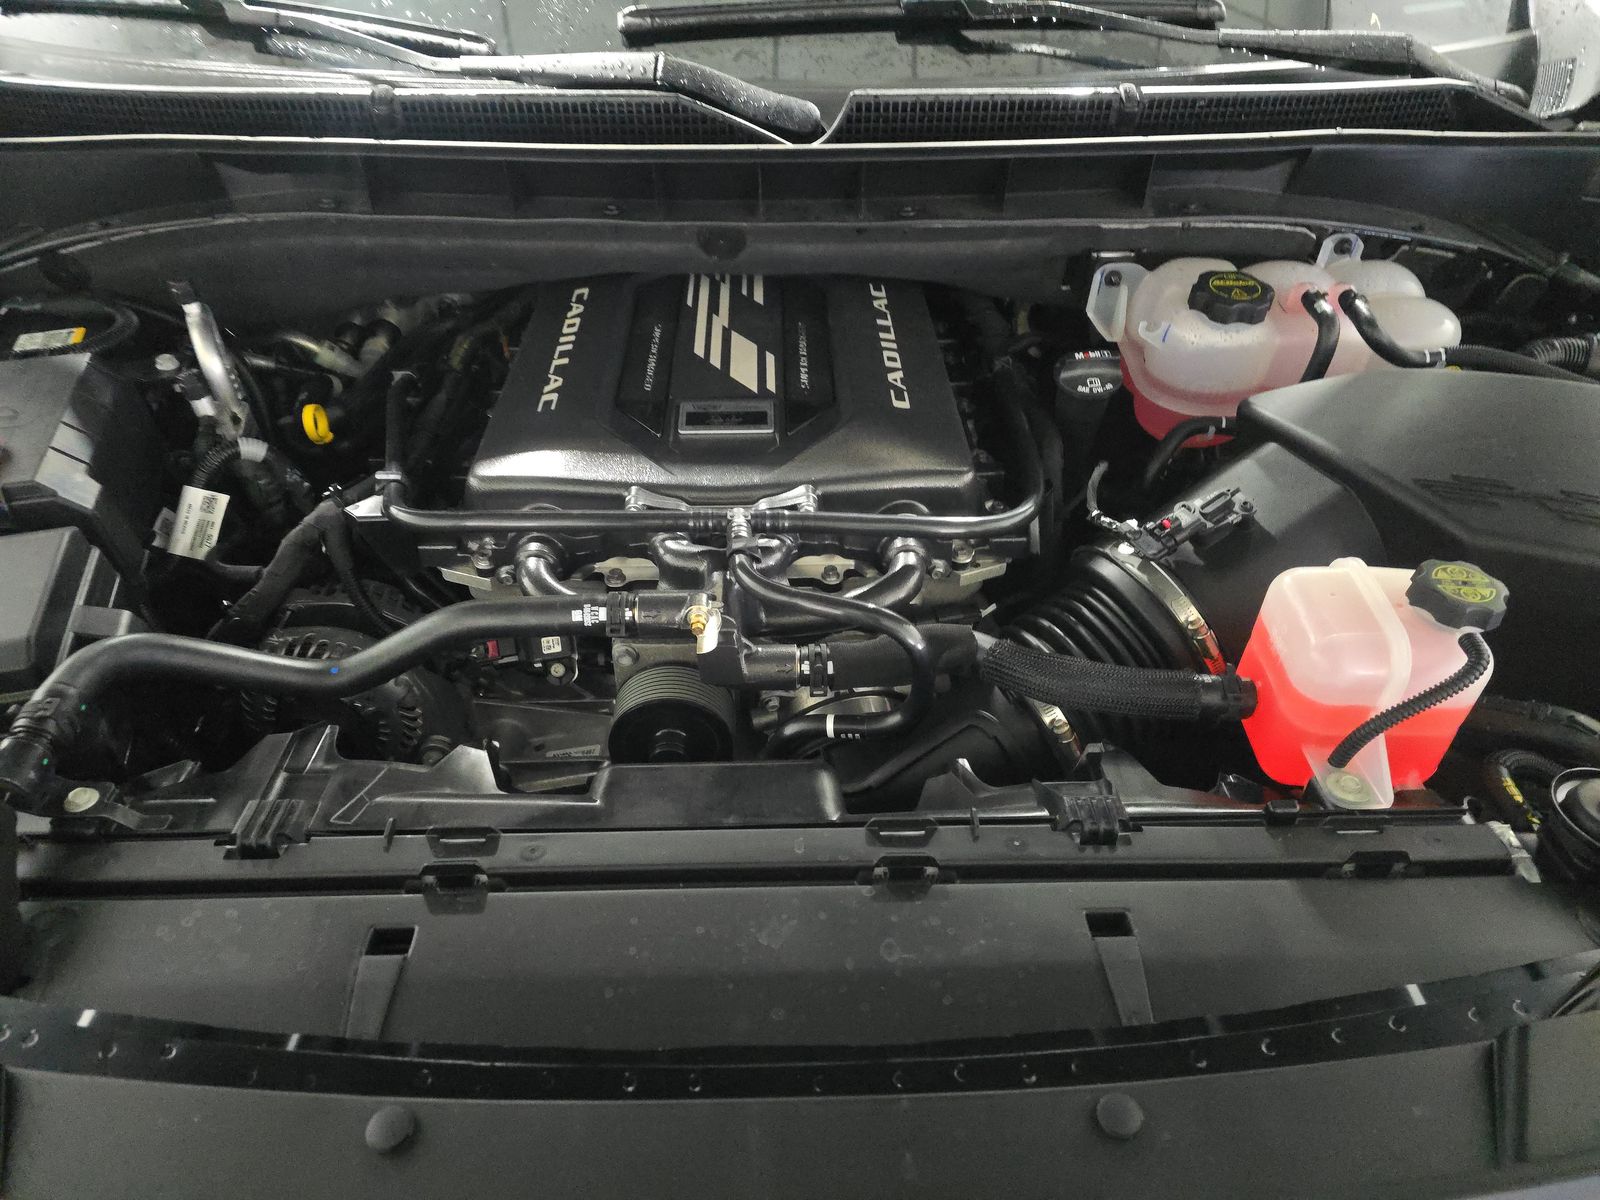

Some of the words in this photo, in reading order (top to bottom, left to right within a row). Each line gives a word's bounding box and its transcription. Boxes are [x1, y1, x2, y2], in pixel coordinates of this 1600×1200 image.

[536, 287, 590, 413] CADILLAC
[868, 282, 911, 409] CADILLAC
[1074, 350, 1101, 361] Mobil
